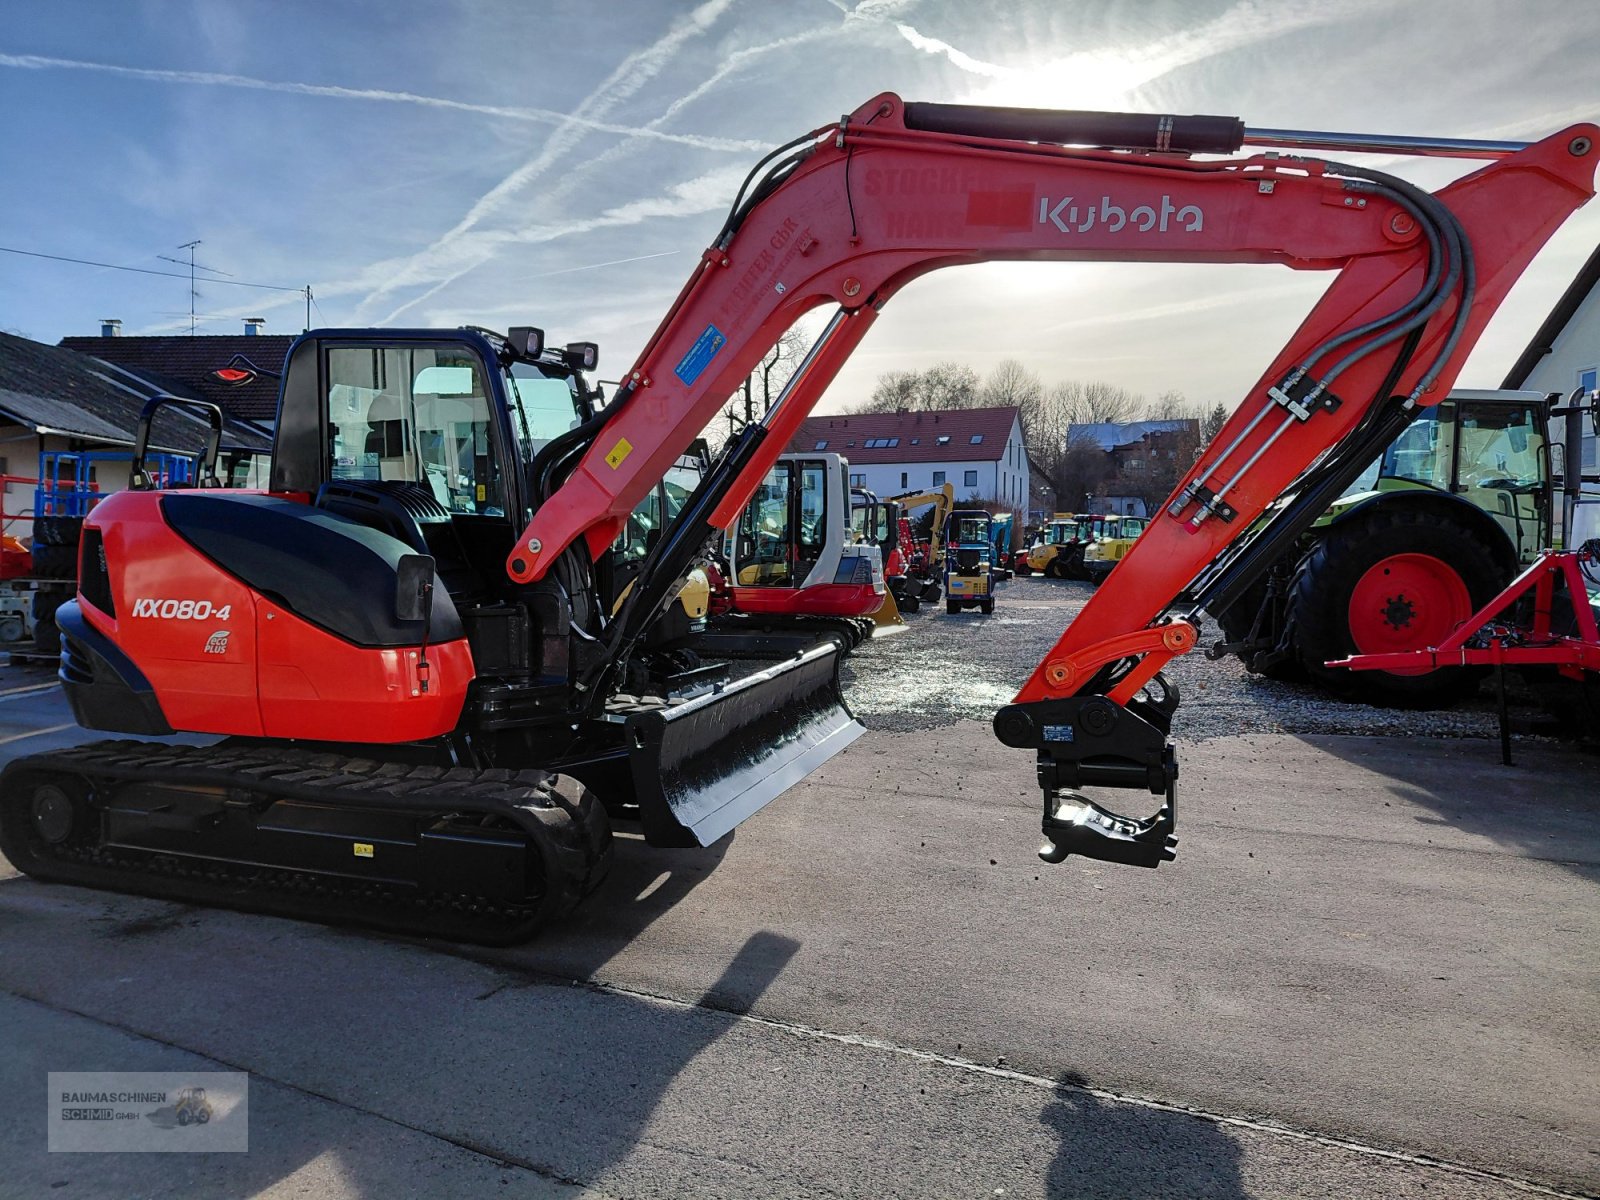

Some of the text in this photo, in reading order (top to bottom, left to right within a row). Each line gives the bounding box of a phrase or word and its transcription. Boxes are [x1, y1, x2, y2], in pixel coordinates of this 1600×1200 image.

[1039, 195, 1204, 233] Kubota
[131, 598, 232, 621] KX080-4
[203, 645, 227, 654] PLUS
